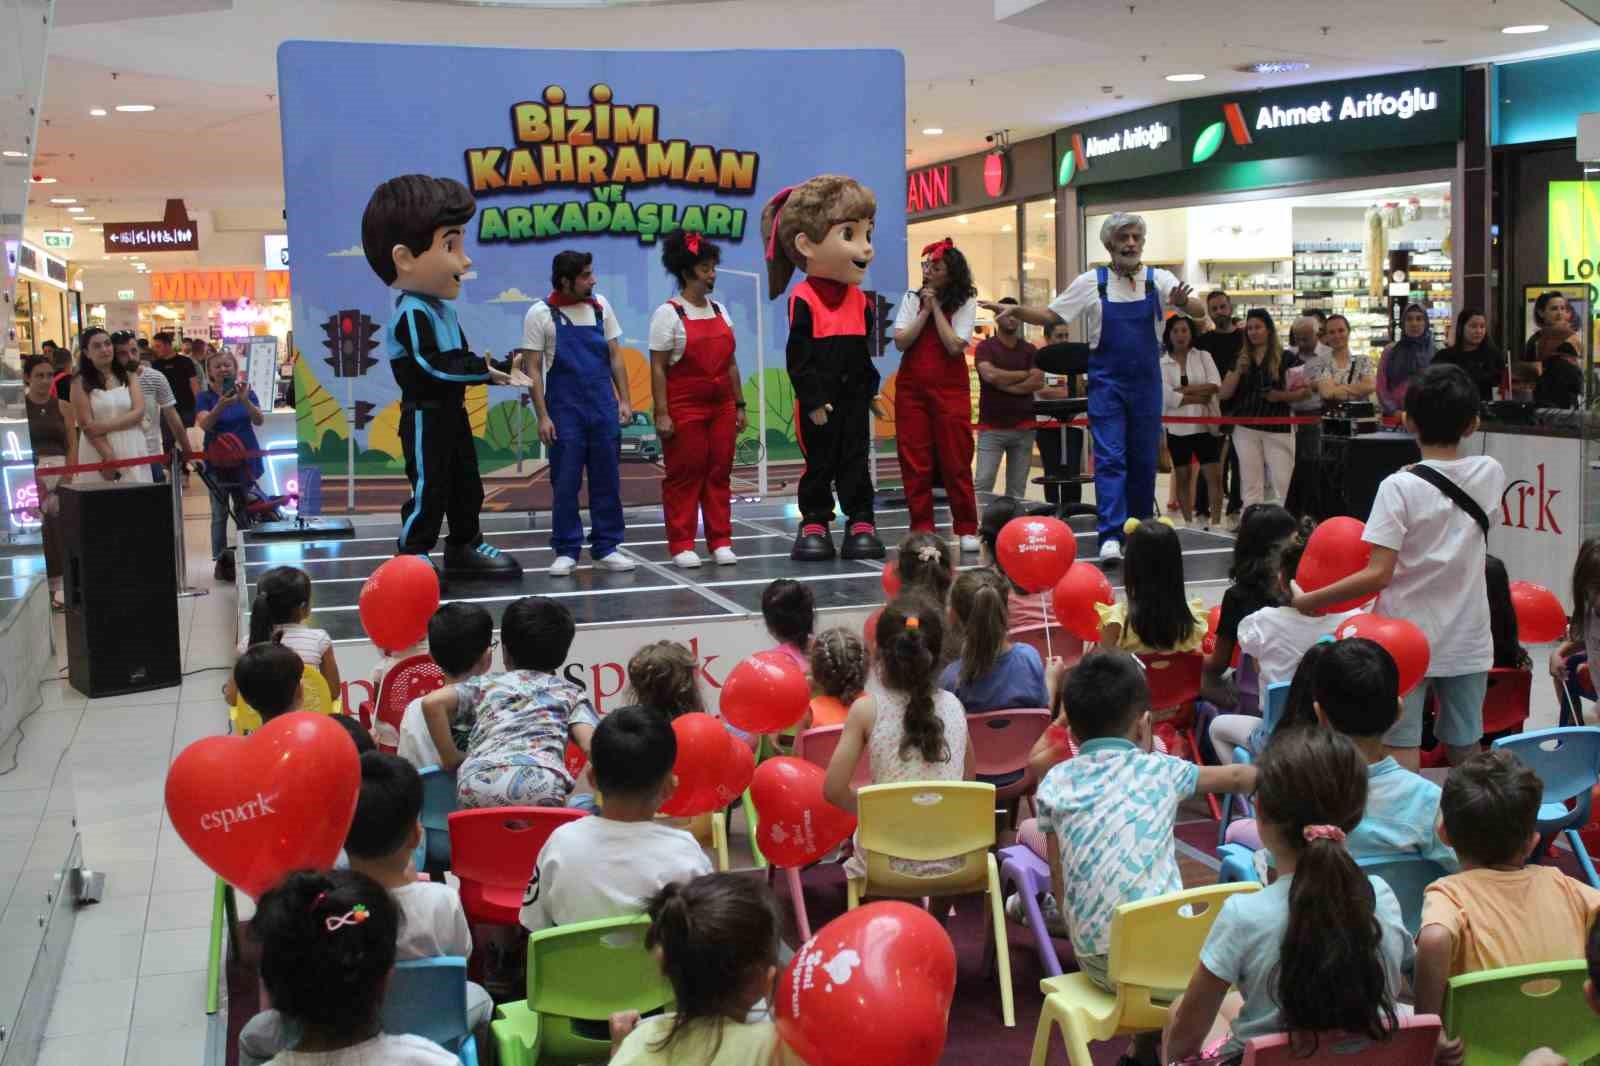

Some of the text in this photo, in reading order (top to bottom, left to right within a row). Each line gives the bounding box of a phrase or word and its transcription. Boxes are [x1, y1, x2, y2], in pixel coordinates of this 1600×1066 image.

[511, 84, 659, 145] BİZİM
[1255, 87, 1437, 130] Ahmet Arifoğlu
[1086, 132, 1121, 157] Ahmet
[467, 140, 758, 194] KAHRAMAN
[595, 183, 625, 203] VE
[478, 201, 747, 245] ARKADAŞLARI
